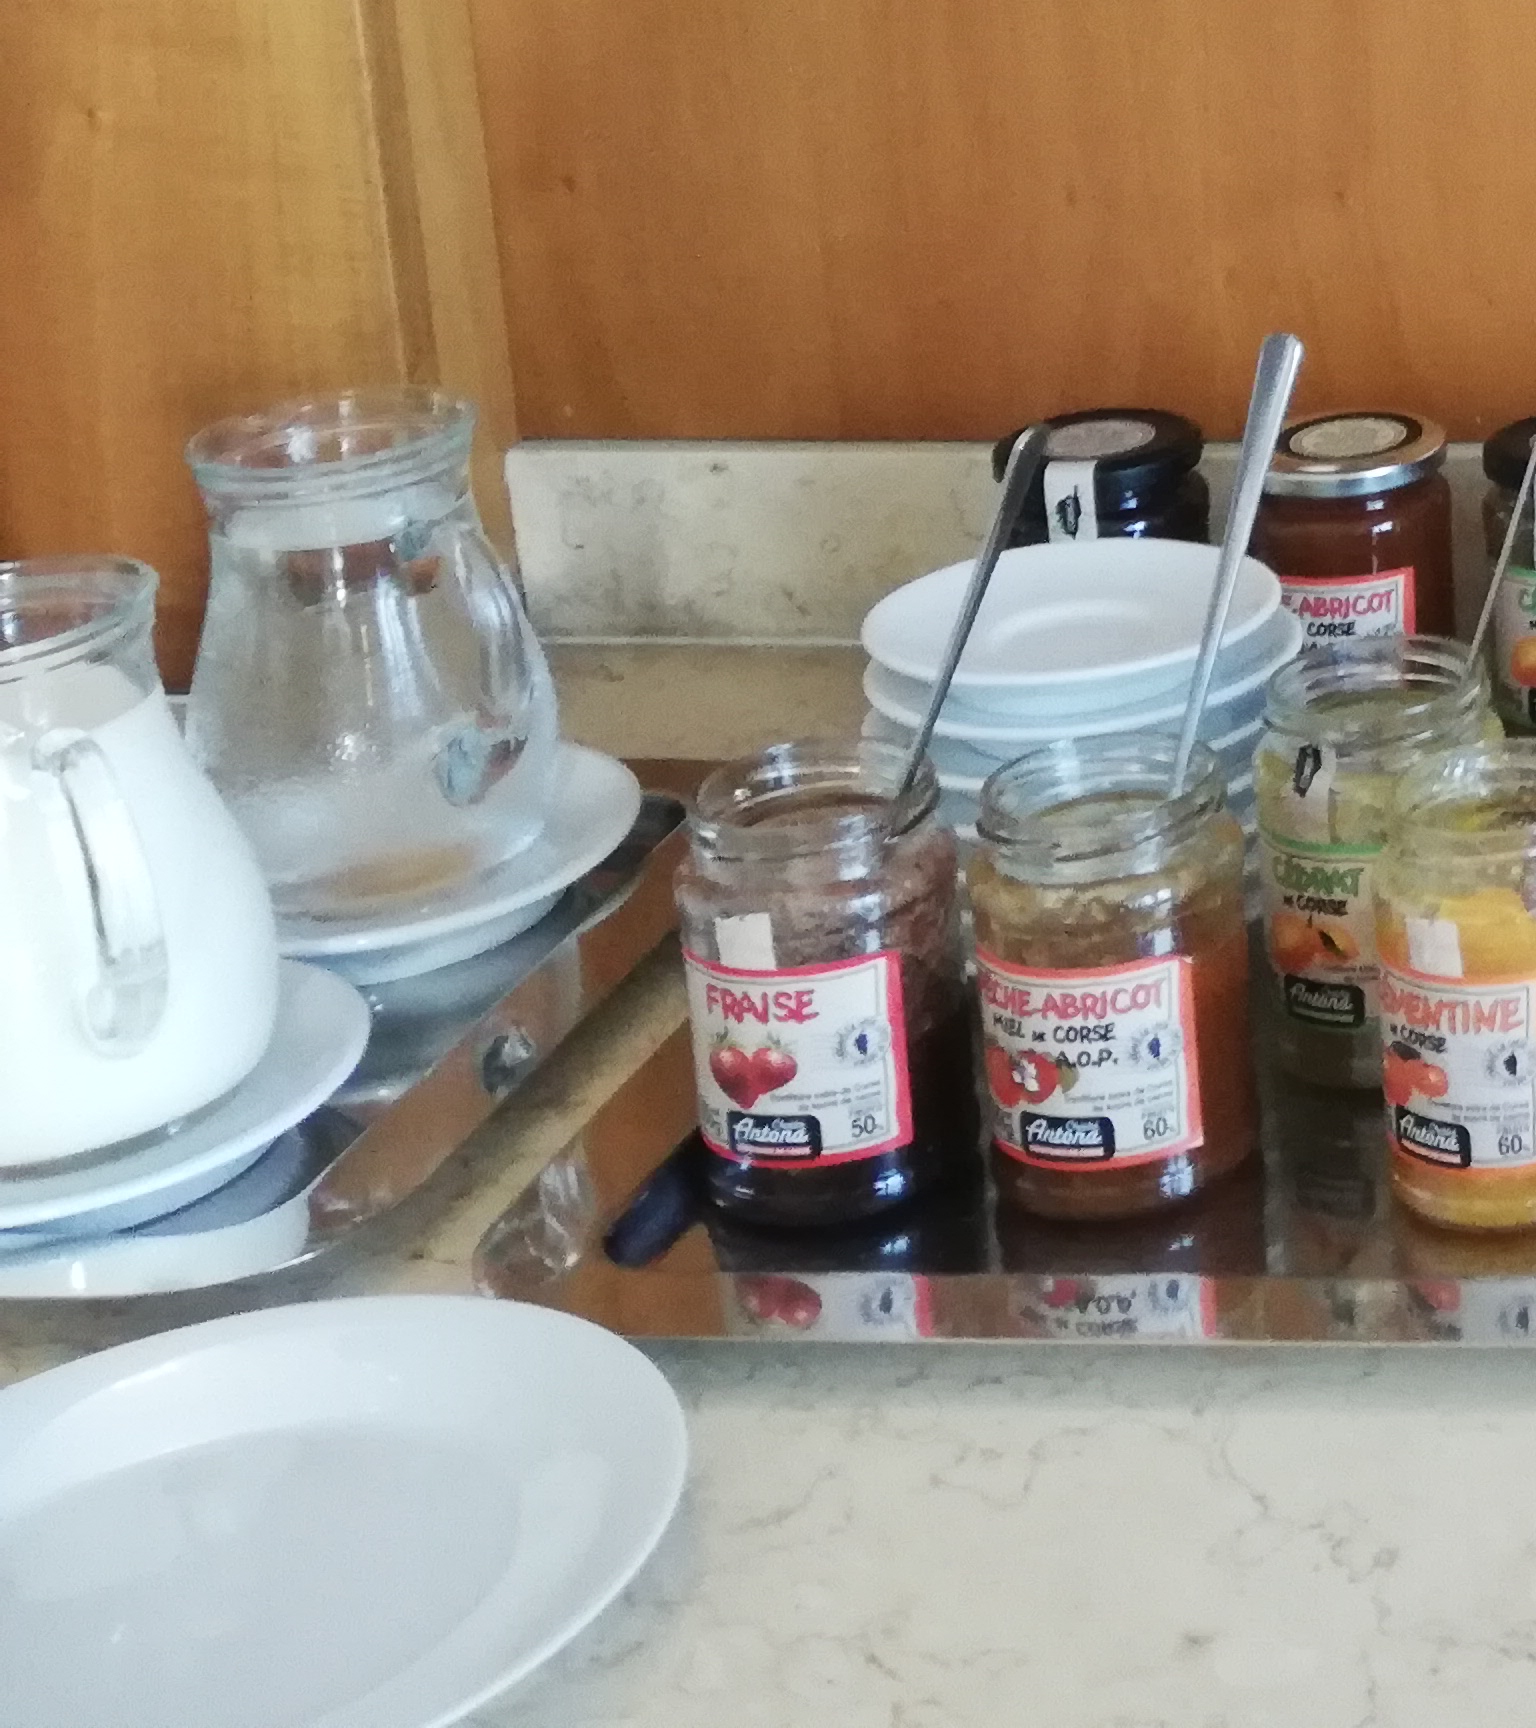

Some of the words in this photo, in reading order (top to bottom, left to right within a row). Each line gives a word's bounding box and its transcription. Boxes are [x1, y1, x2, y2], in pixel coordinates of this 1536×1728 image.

[1306, 620, 1356, 639] CORSE
[706, 982, 820, 1024] FRAISE
[1053, 1022, 1116, 1045] CORSE
